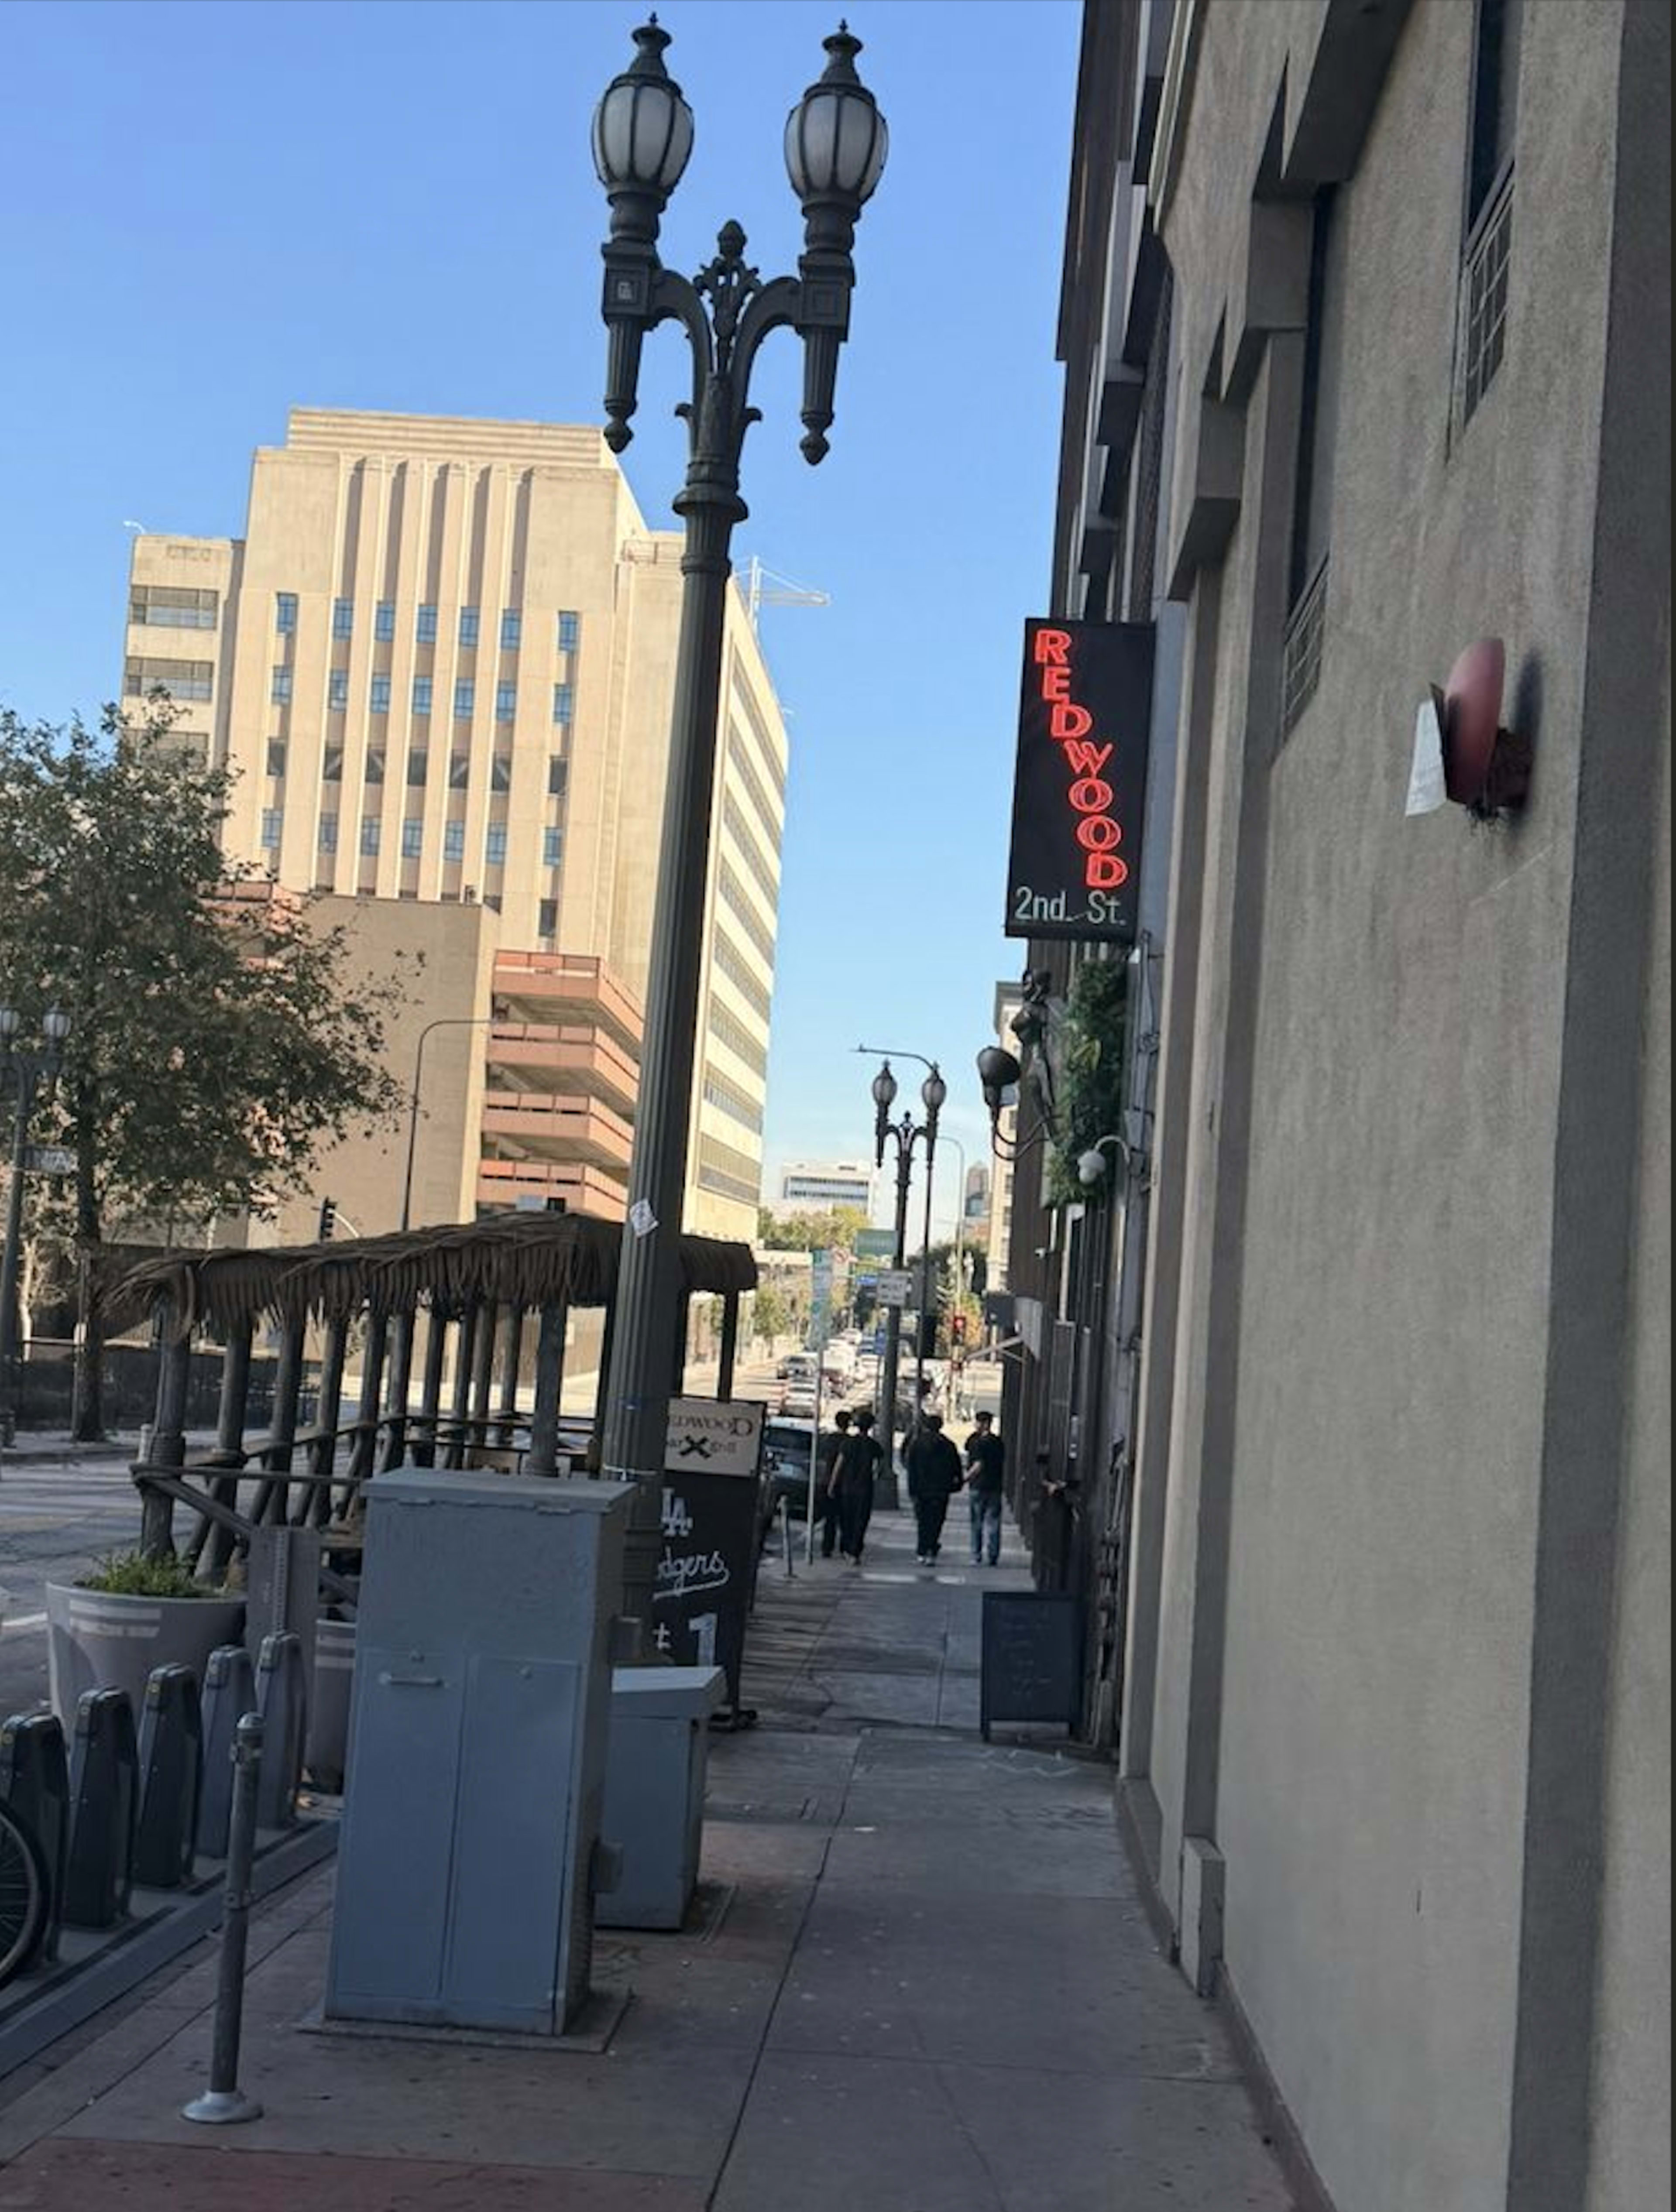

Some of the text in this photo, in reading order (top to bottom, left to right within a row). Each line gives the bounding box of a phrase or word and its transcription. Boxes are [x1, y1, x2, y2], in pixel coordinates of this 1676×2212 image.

[1034, 629, 1128, 888] REDWOOD
[662, 1488, 694, 1536] LA
[655, 1546, 730, 1597] dgers
